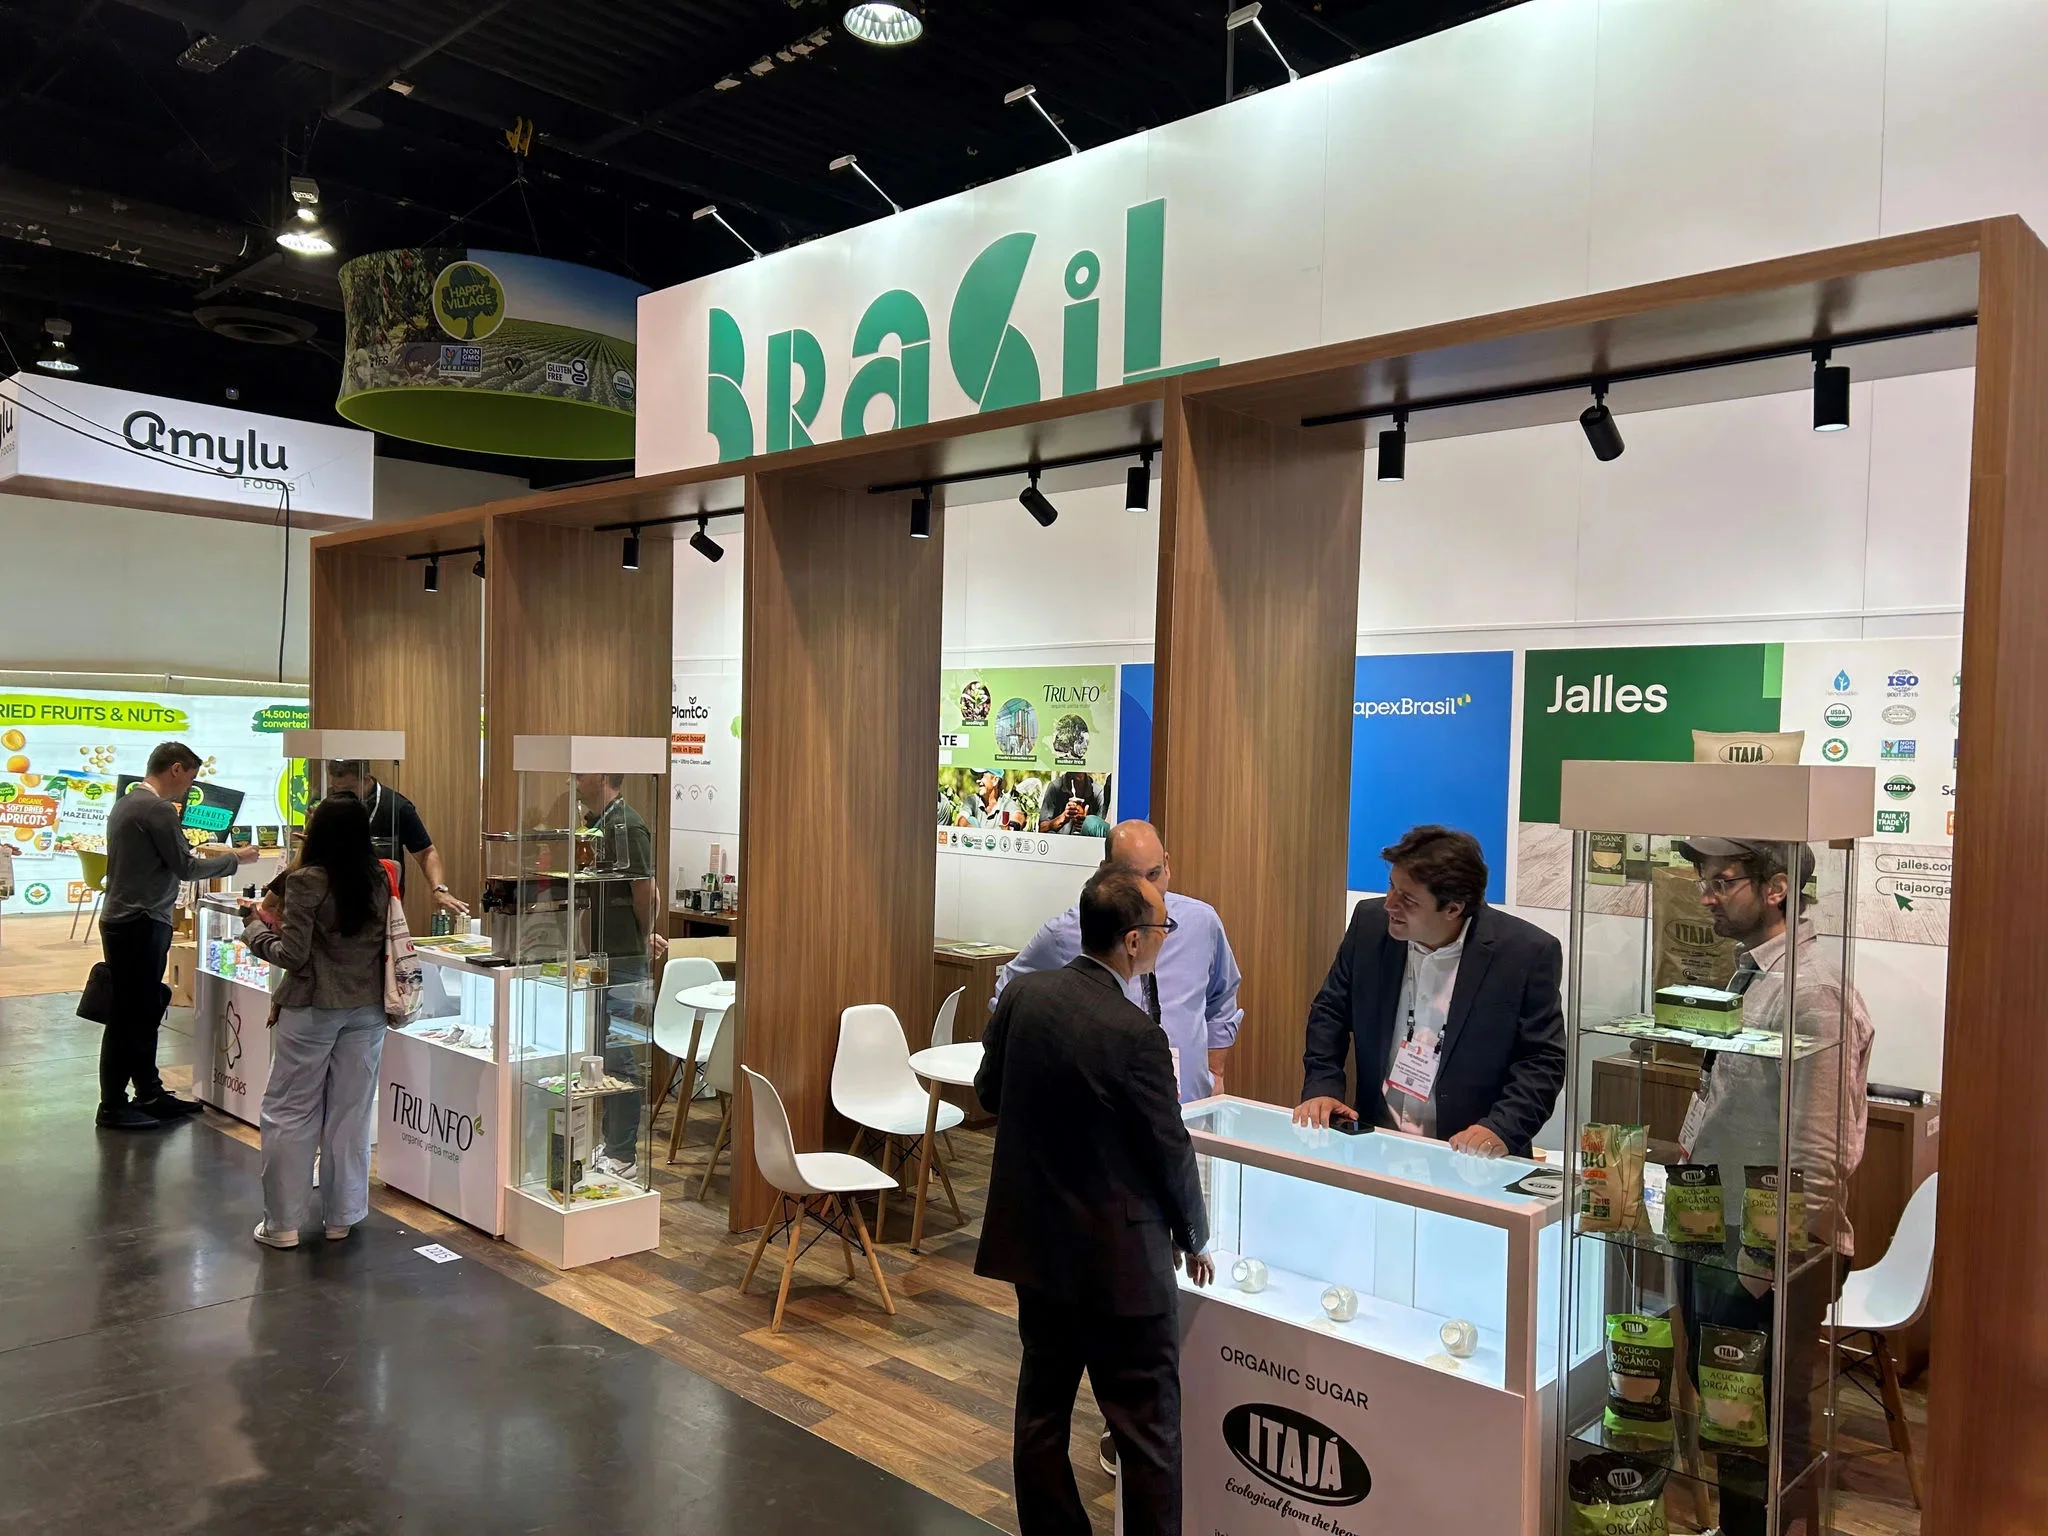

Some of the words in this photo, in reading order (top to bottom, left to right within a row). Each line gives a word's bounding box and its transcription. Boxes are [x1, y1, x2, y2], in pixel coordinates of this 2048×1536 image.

[450, 284, 486, 298] HAPPY
[446, 294, 492, 309] VILLAGE
[547, 363, 572, 375] GLUTEN
[547, 372, 562, 381] FREE
[123, 410, 288, 478] amylu
[243, 478, 296, 492] FOODS
[1887, 675, 1919, 687] ISO
[1043, 684, 1100, 702] TRIUNFO
[1547, 673, 1668, 713] Jalles
[41, 705, 106, 721] FRUITS
[110, 708, 123, 721] &
[128, 708, 175, 723] NUTS
[672, 705, 708, 719] PlantCo
[1353, 696, 1457, 718] apexBrasil
[262, 720, 307, 729] converted
[0, 812, 48, 826] APRICOTS
[1592, 834, 1623, 842] ORGANIC
[390, 1082, 473, 1151] TRIUNFO
[401, 1131, 423, 1149] organic
[424, 1142, 442, 1156] yerba
[1220, 1346, 1300, 1385] ORGANIC
[1305, 1374, 1369, 1410] SUGAR
[1249, 1412, 1342, 1491] ITAJÁ
[1225, 1477, 1282, 1511] Ecological
[1281, 1500, 1310, 1518] from
[1311, 1514, 1331, 1531] the
